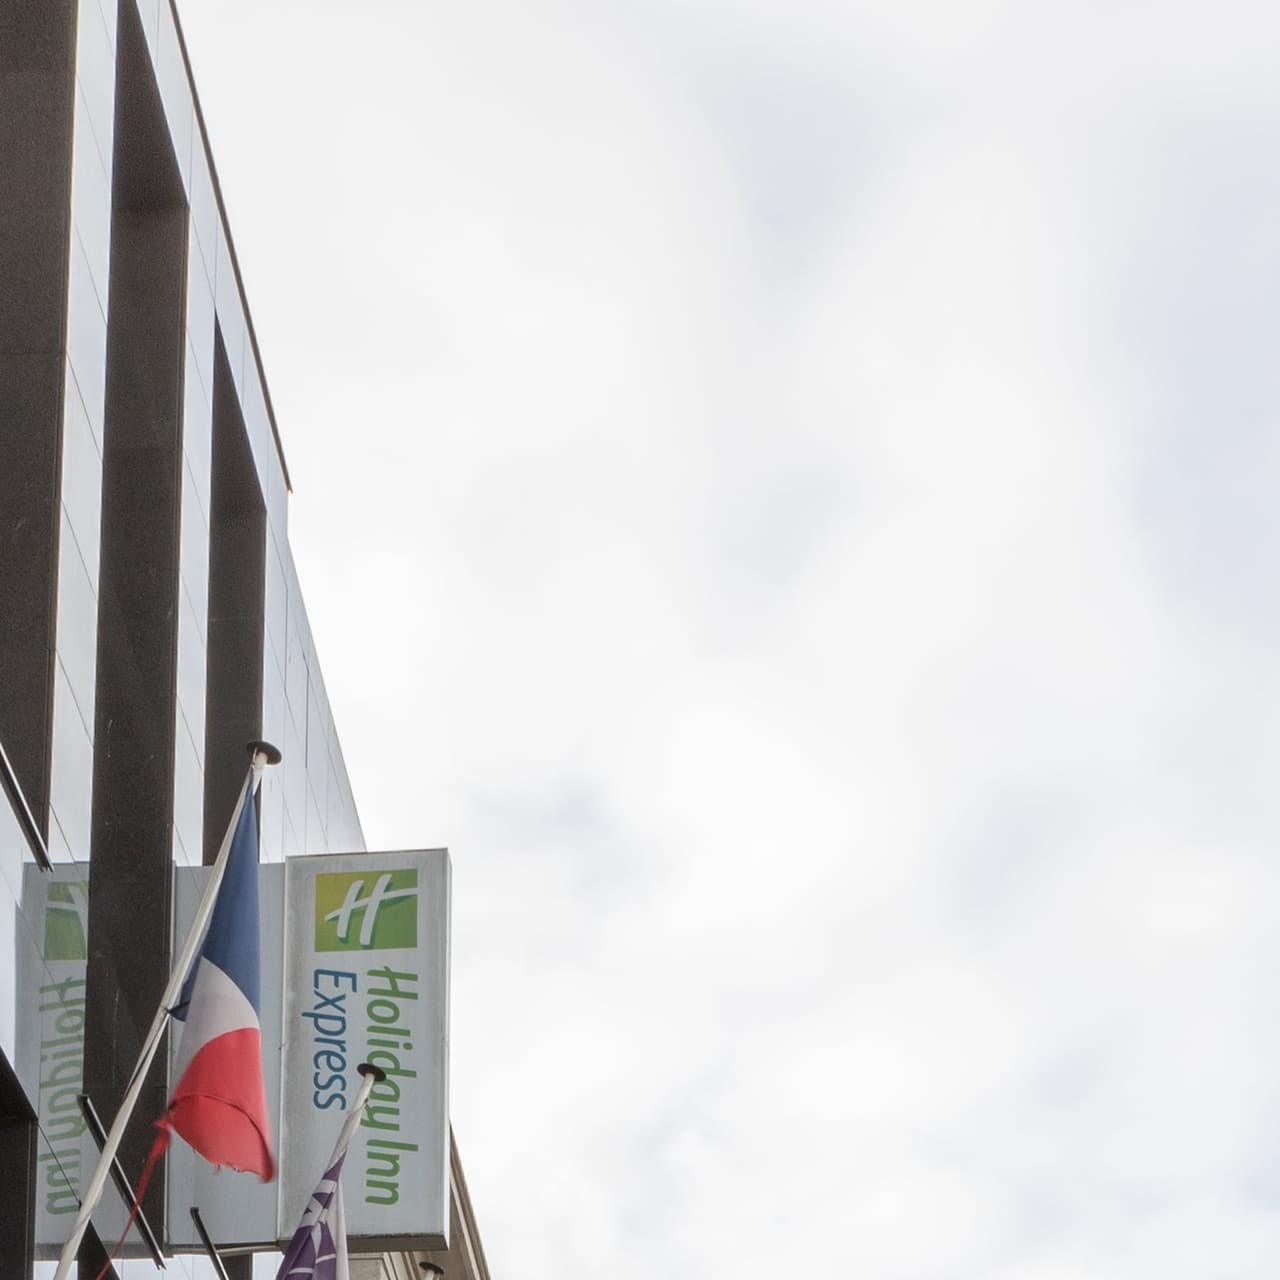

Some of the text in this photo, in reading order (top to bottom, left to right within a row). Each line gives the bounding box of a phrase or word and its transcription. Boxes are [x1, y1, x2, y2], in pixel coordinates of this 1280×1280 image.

[301, 968, 357, 1111] Express
[359, 966, 418, 1206] Holiday Inn
